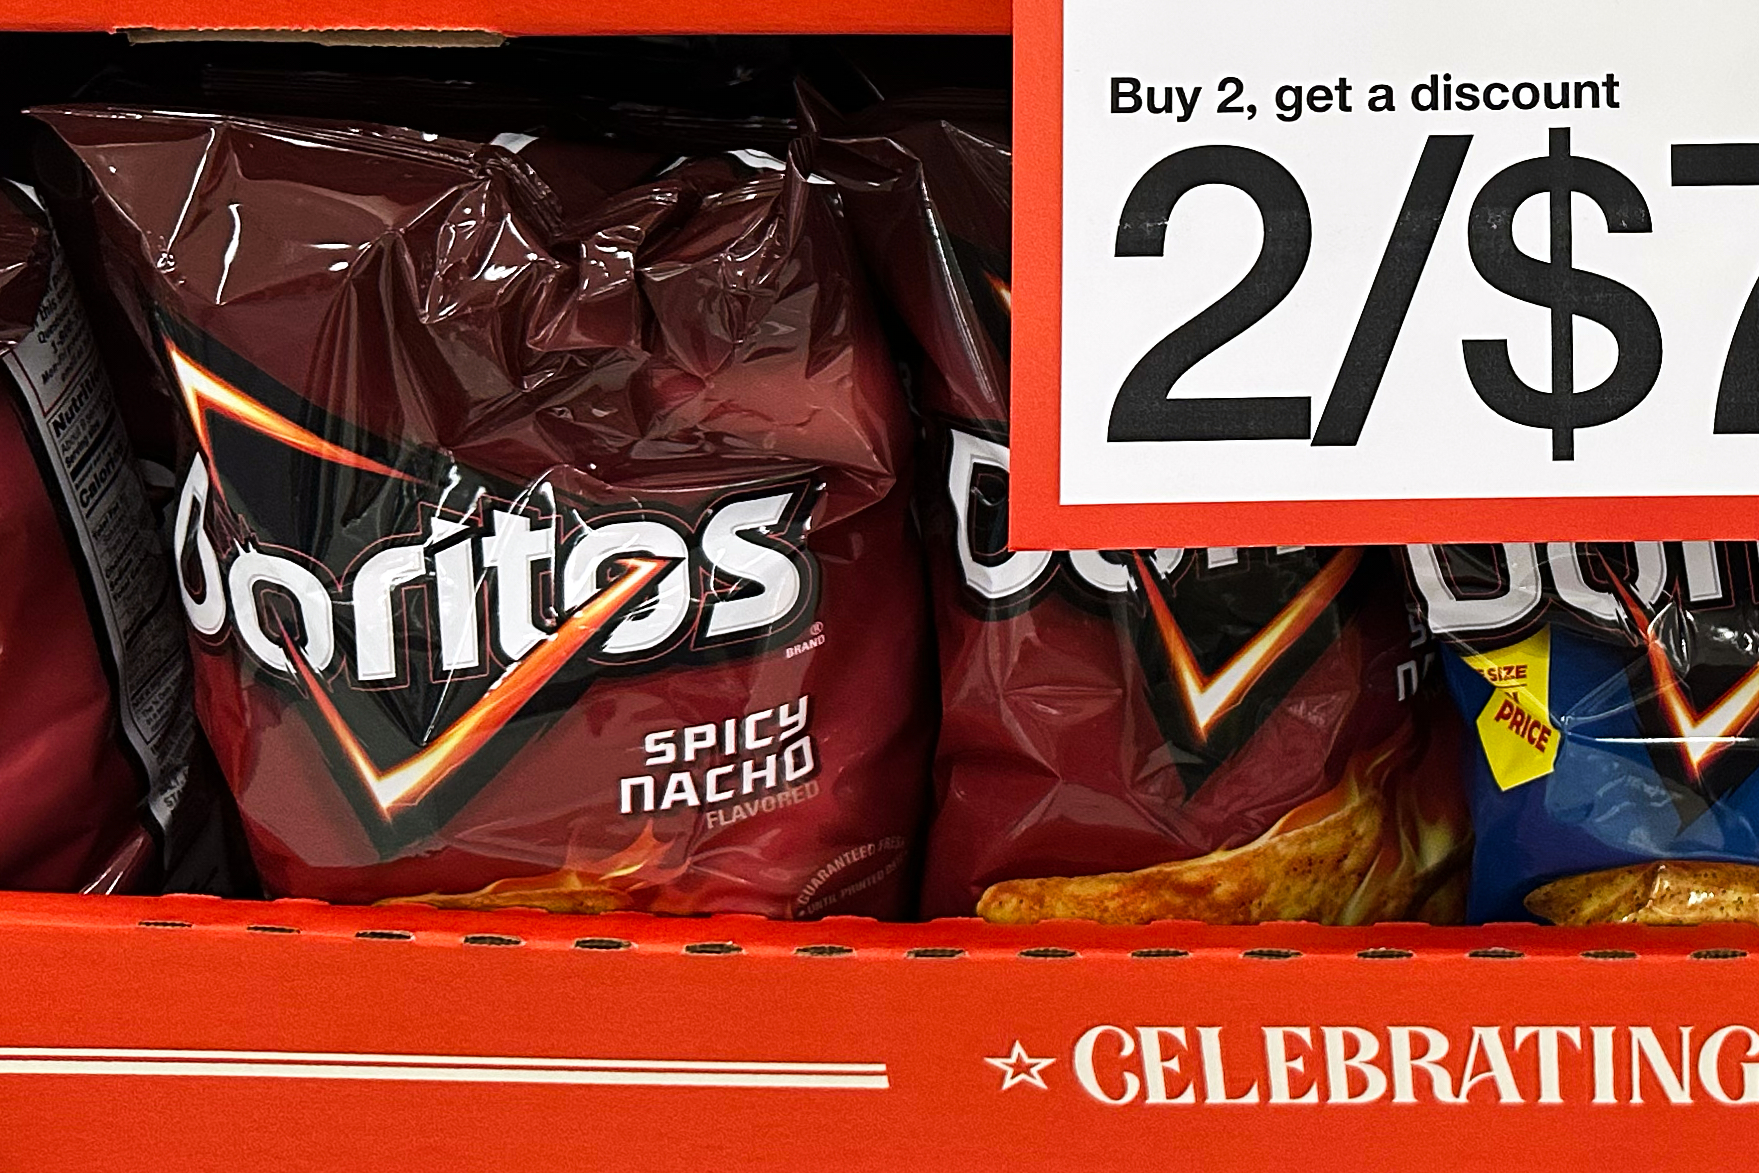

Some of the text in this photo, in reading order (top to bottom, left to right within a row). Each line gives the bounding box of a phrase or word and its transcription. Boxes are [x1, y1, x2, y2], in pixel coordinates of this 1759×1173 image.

[1110, 72, 1620, 124] Buy 2, get a discount
[785, 634, 826, 659] BRAND
[1487, 664, 1528, 682] SIZE
[644, 695, 809, 767] SPICY
[1493, 698, 1552, 754] PRICE
[619, 735, 817, 815] NACHO
[705, 779, 820, 830] FLAVORED
